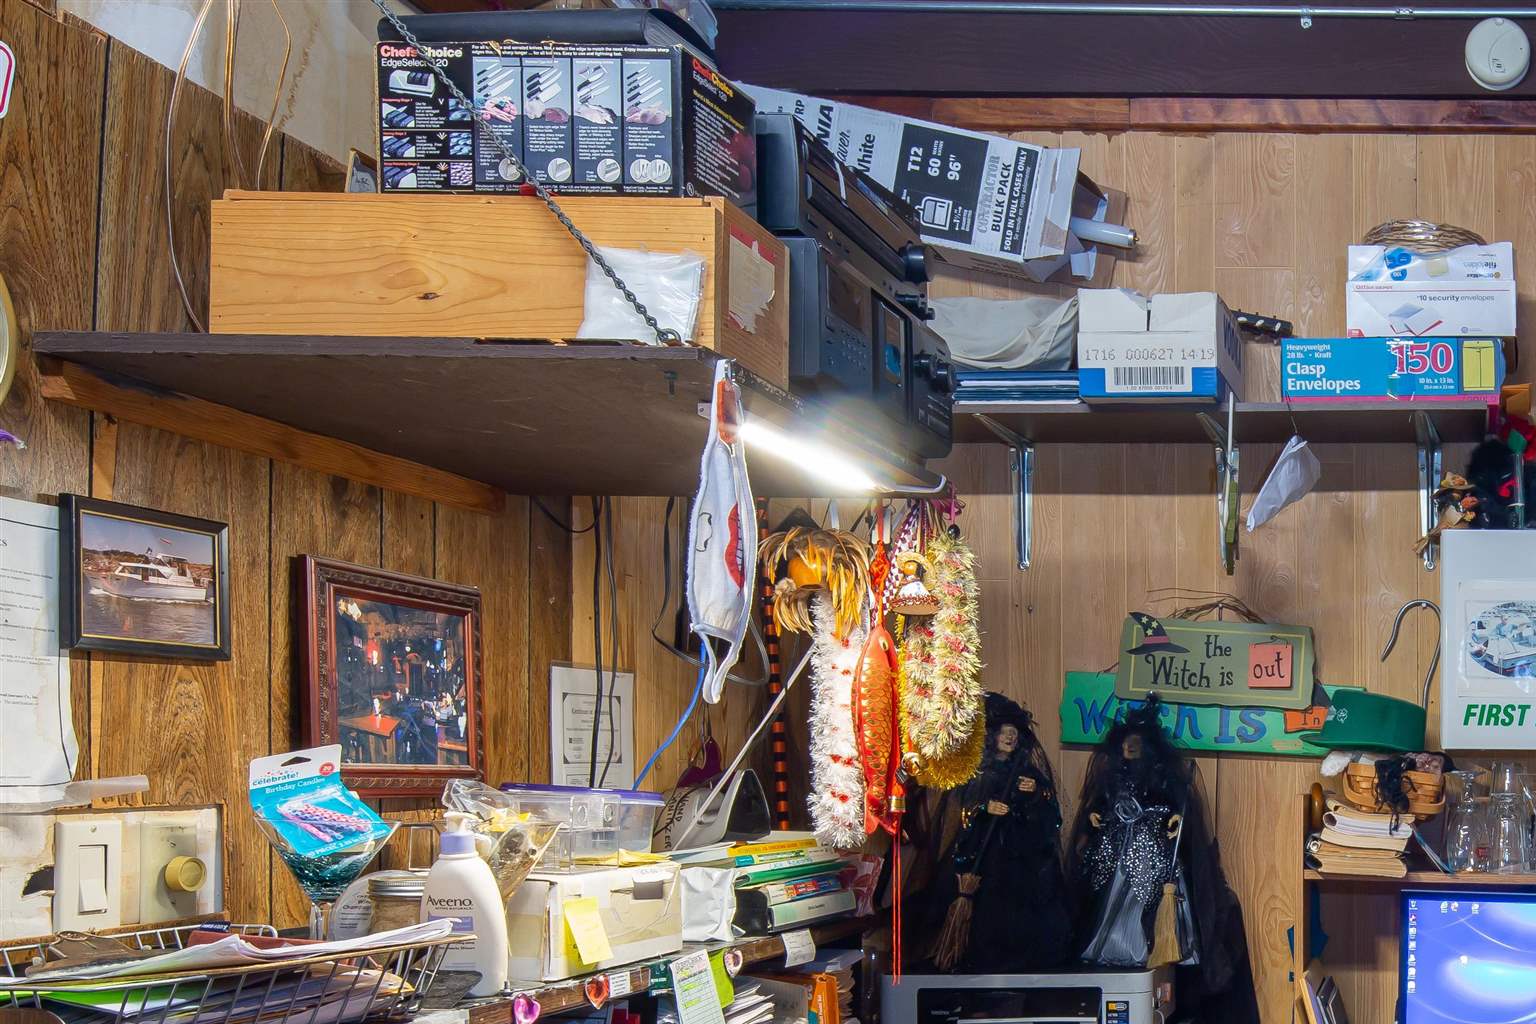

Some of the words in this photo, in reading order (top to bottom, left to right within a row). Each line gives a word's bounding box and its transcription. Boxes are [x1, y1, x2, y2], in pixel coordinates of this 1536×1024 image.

[907, 146, 924, 172] T12
[928, 157, 942, 177] 60
[1017, 149, 1028, 172] ONLY
[976, 155, 1001, 234] CONTRACTOR
[1012, 172, 1023, 197] CASES
[991, 200, 1005, 233] BULK
[998, 162, 1012, 196] PACK
[1009, 196, 1019, 218] FULL
[1008, 218, 1014, 229] IN
[1004, 230, 1013, 251] SOLD
[1428, 294, 1460, 302] security
[1460, 294, 1495, 302] envelopes
[1085, 349, 1116, 361] 1716
[1126, 348, 1174, 361] 000627
[1286, 344, 1331, 352] Heavyweight
[1314, 351, 1332, 359] Kraft
[1392, 342, 1454, 376] 150
[1286, 362, 1326, 378] Clasp
[1287, 378, 1361, 394] Envelopes
[1204, 634, 1232, 659] the
[1144, 654, 1211, 690] Witch
[1218, 666, 1234, 686] is
[1252, 652, 1285, 679] out
[1463, 704, 1531, 727] FIRST
[265, 783, 296, 794] Birthday
[297, 777, 326, 788] Candles
[426, 896, 472, 907] Aveeno
